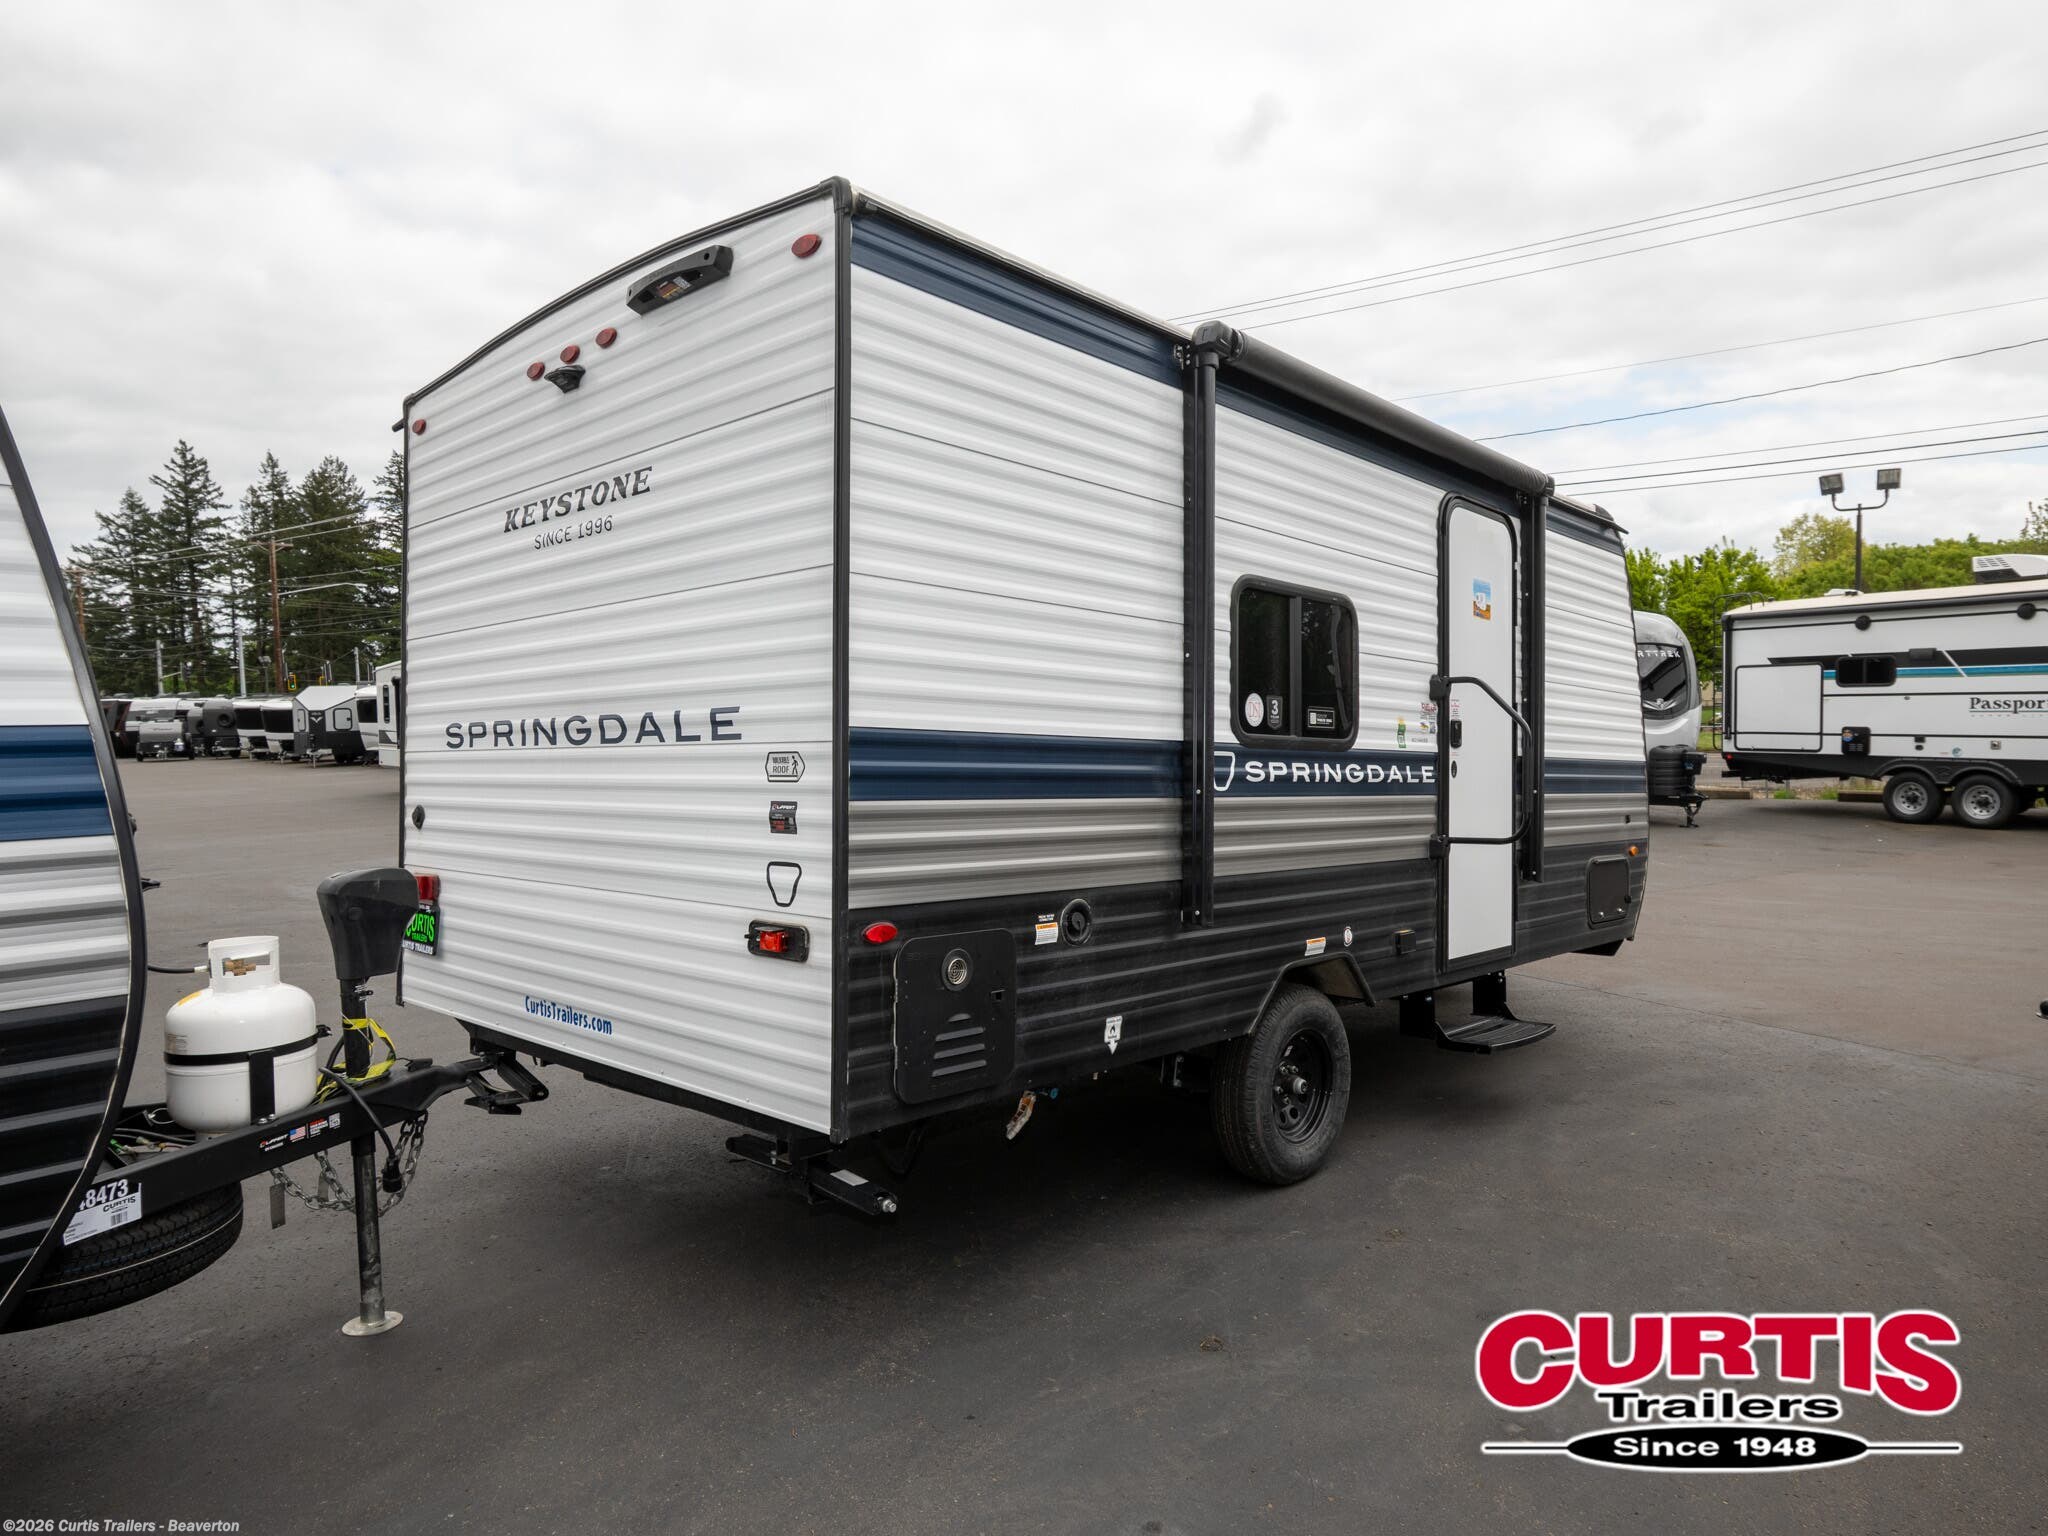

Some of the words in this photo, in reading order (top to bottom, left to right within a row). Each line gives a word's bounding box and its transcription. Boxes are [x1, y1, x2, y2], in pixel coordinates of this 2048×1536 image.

[503, 466, 653, 533] KEYSTONE
[534, 525, 572, 550] SINCE
[577, 514, 613, 539] 1996
[1637, 650, 1681, 658] RTTREK
[1271, 700, 1279, 715] 3
[1969, 697, 2048, 714] Passpor
[445, 706, 742, 749] SPRINGDALE
[772, 765, 790, 774] ROOF
[1244, 760, 1436, 783] SPRINGDALE
[525, 995, 613, 1035] CurtisTrailers.com
[102, 1196, 136, 1212] CURTIS
